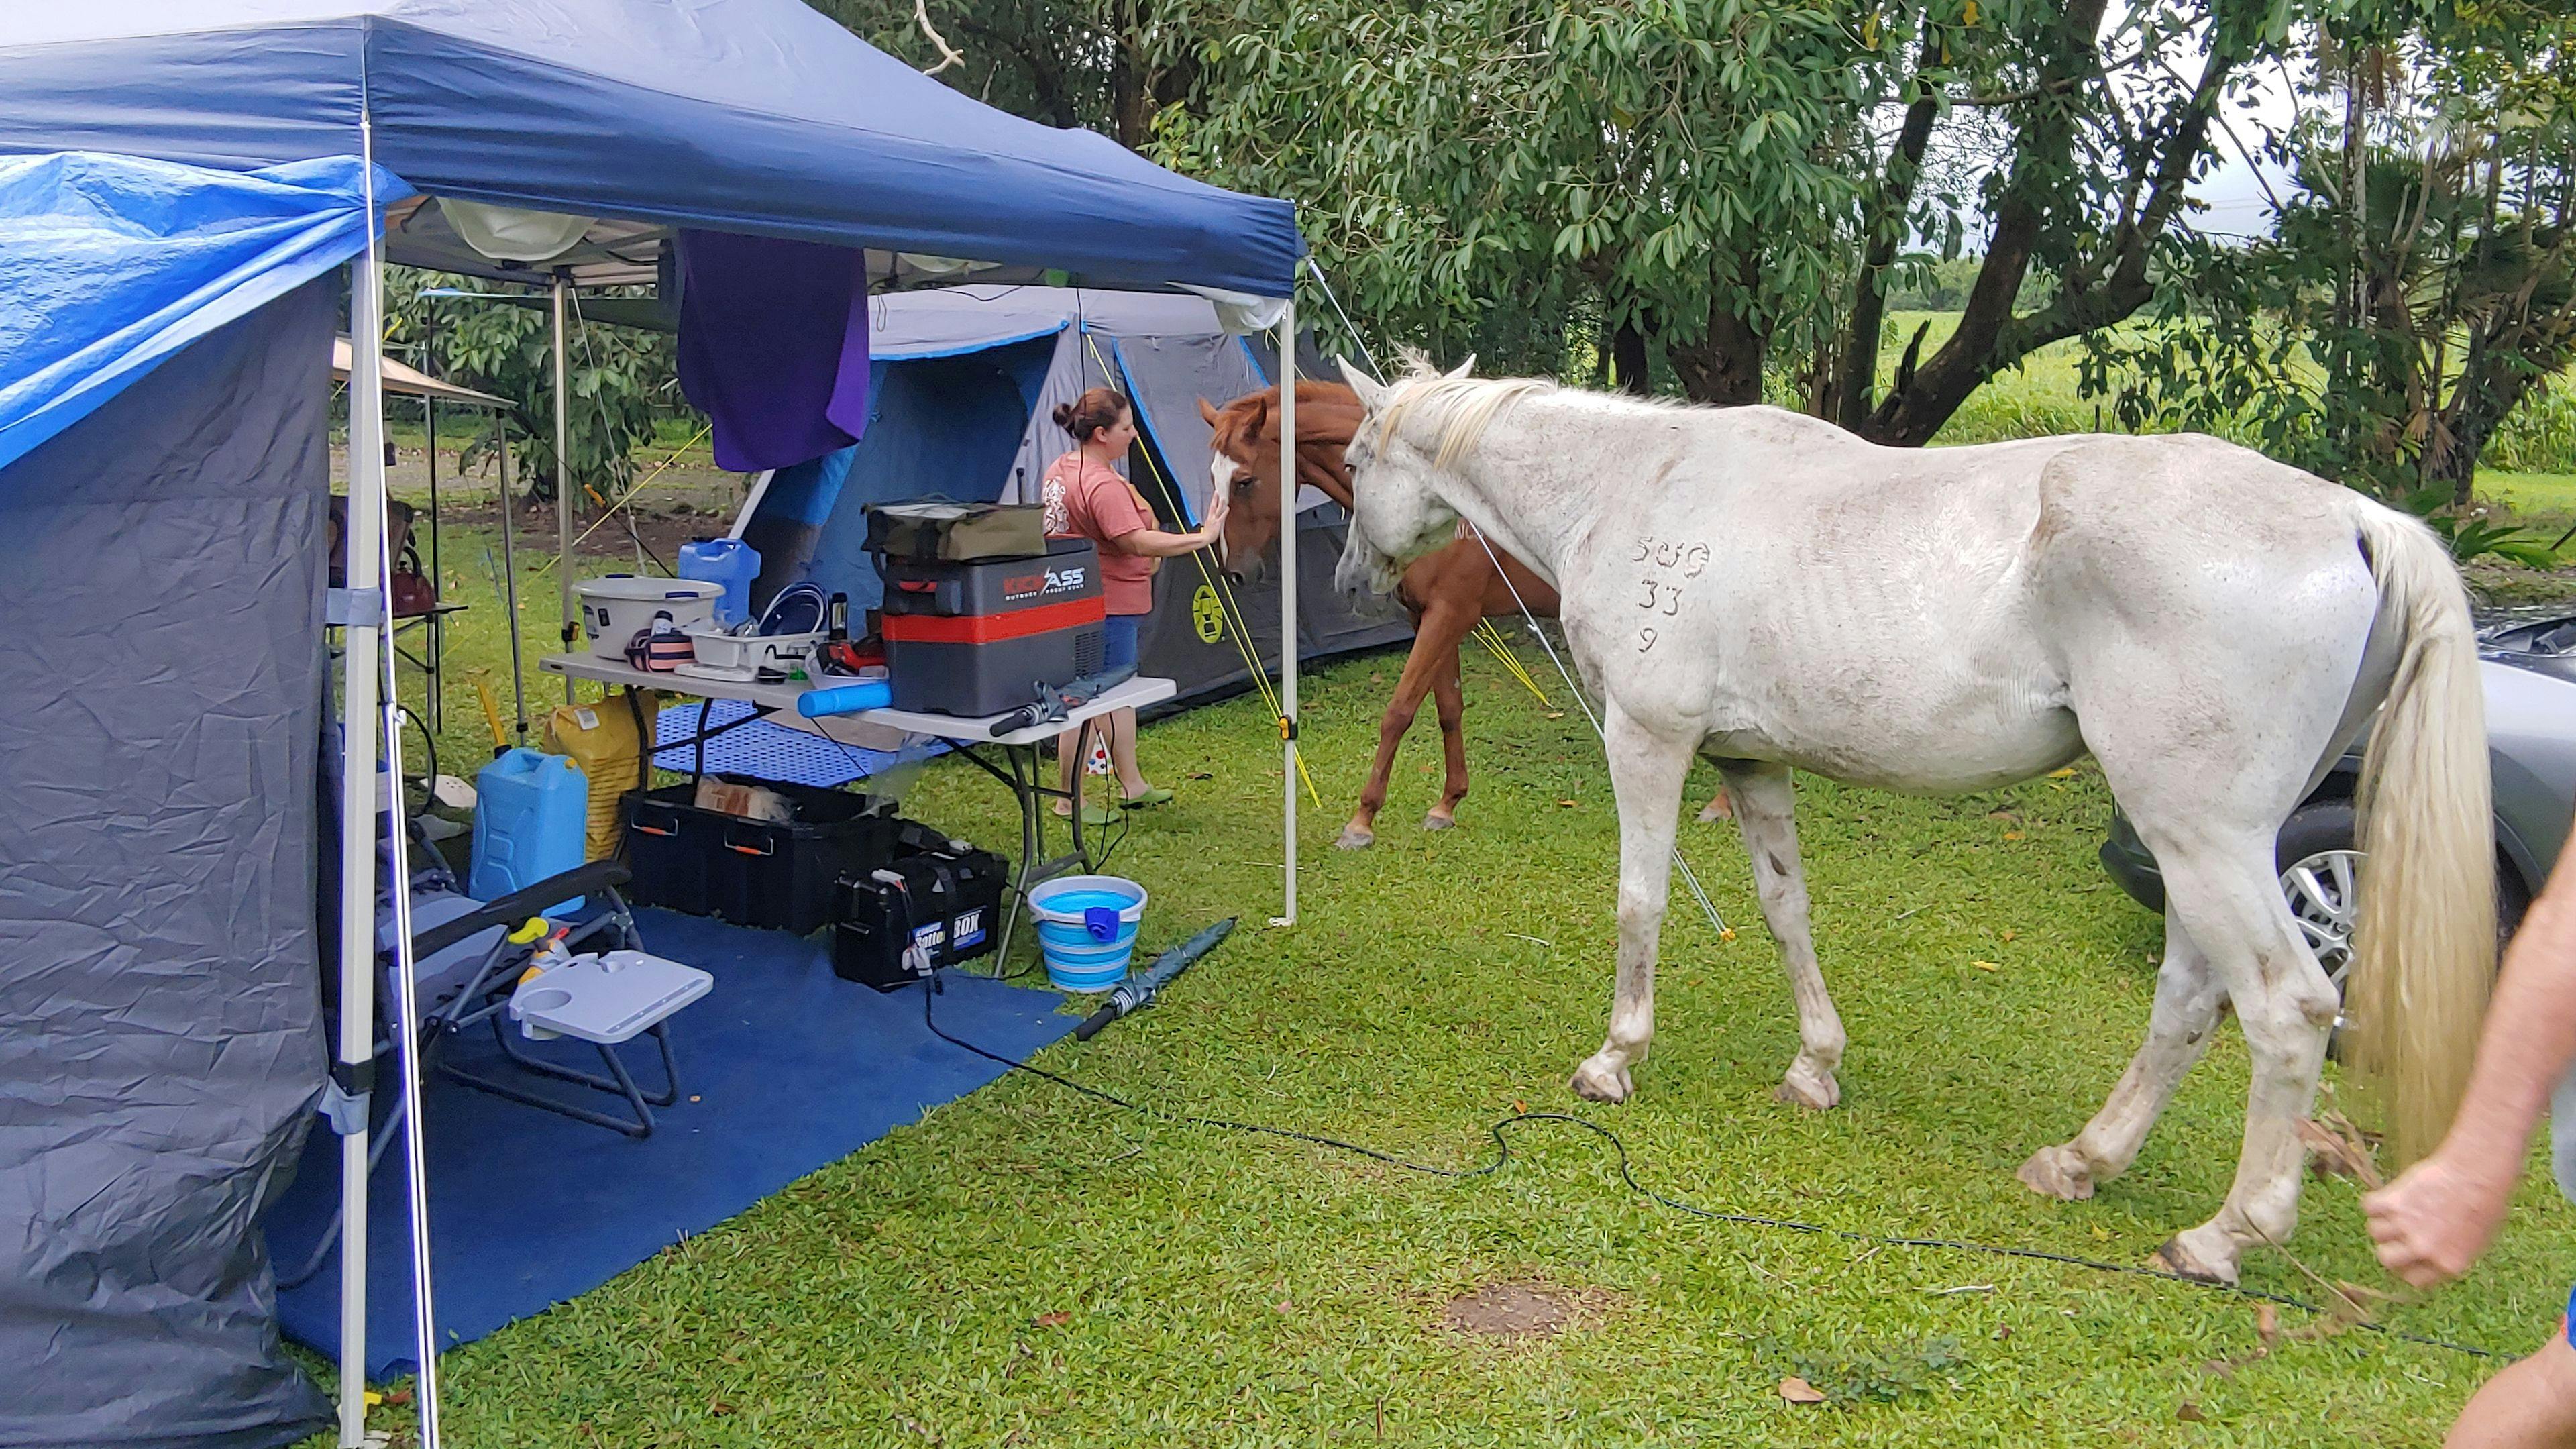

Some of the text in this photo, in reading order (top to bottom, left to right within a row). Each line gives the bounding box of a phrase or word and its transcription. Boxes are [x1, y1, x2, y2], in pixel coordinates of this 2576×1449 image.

[1638, 579, 1682, 616] 33
[1638, 627, 1658, 653] 9
[953, 913, 980, 939] BOX
